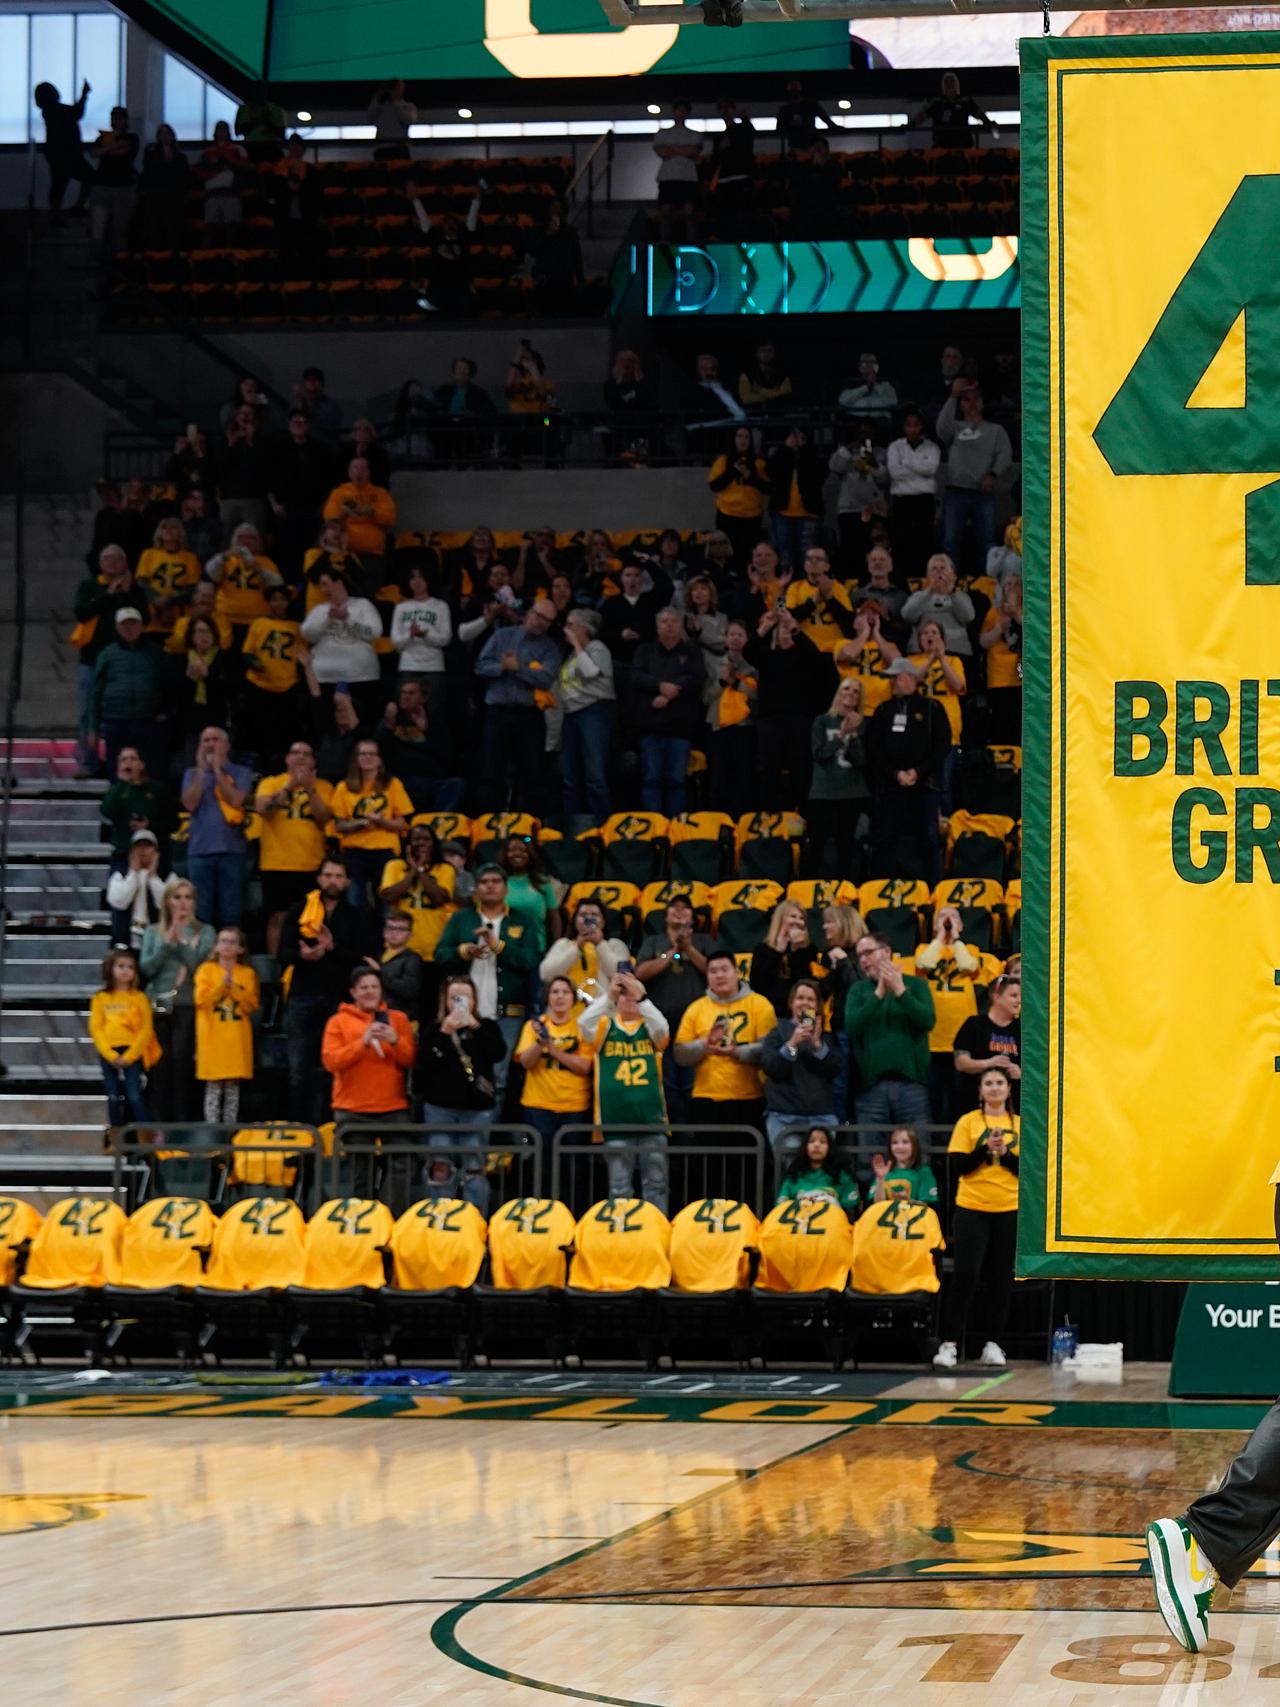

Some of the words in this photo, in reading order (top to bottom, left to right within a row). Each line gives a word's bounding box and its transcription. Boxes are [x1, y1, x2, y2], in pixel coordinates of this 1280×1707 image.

[152, 562, 187, 588] 42
[260, 631, 295, 660] 42
[486, 813, 522, 839] 42
[616, 816, 651, 839] 42
[749, 811, 782, 838] 42
[879, 879, 916, 907] 42
[948, 880, 986, 908] 42
[928, 958, 965, 992] 42
[614, 1059, 650, 1087] 42
[60, 1198, 110, 1236] 42
[152, 1200, 200, 1239] 42
[241, 1198, 292, 1235] 42
[328, 1198, 377, 1235] 42
[416, 1198, 469, 1232] 42
[505, 1198, 554, 1234] 42
[595, 1198, 644, 1233] 42
[694, 1199, 742, 1234] 42
[779, 1200, 829, 1235] 42
[878, 1200, 927, 1240] 42
[1205, 1304, 1263, 1328] Your
[2, 1394, 1056, 1424] BAYLOR
